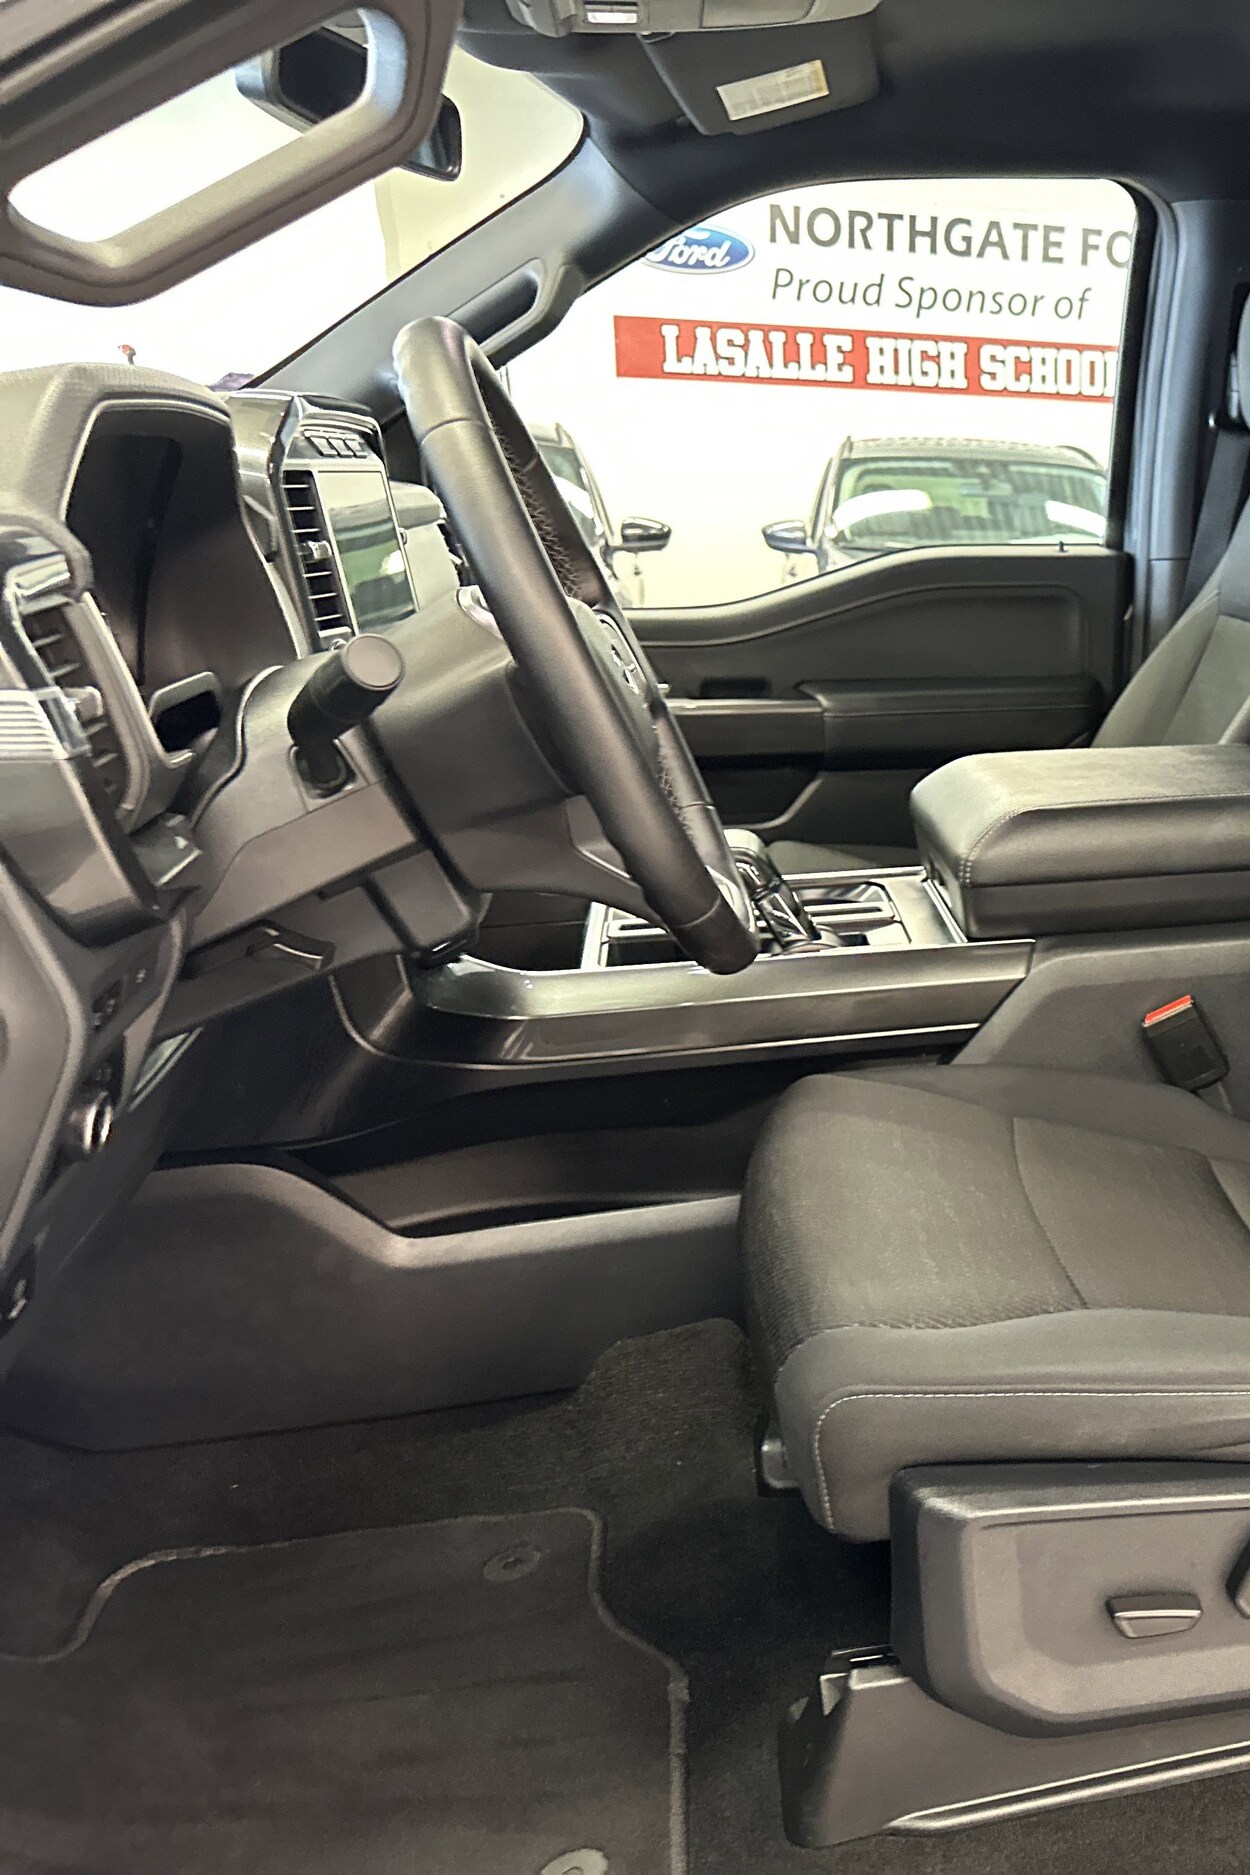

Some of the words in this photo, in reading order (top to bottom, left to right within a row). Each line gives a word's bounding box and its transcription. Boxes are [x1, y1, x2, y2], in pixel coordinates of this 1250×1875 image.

[646, 230, 731, 268] Ford
[769, 204, 1066, 264] NORTHGATE
[772, 268, 885, 307] Proud
[895, 276, 1044, 319] Sponsor
[1054, 287, 1092, 320] of
[660, 323, 854, 383] LASALLE
[866, 336, 968, 390] HIGH
